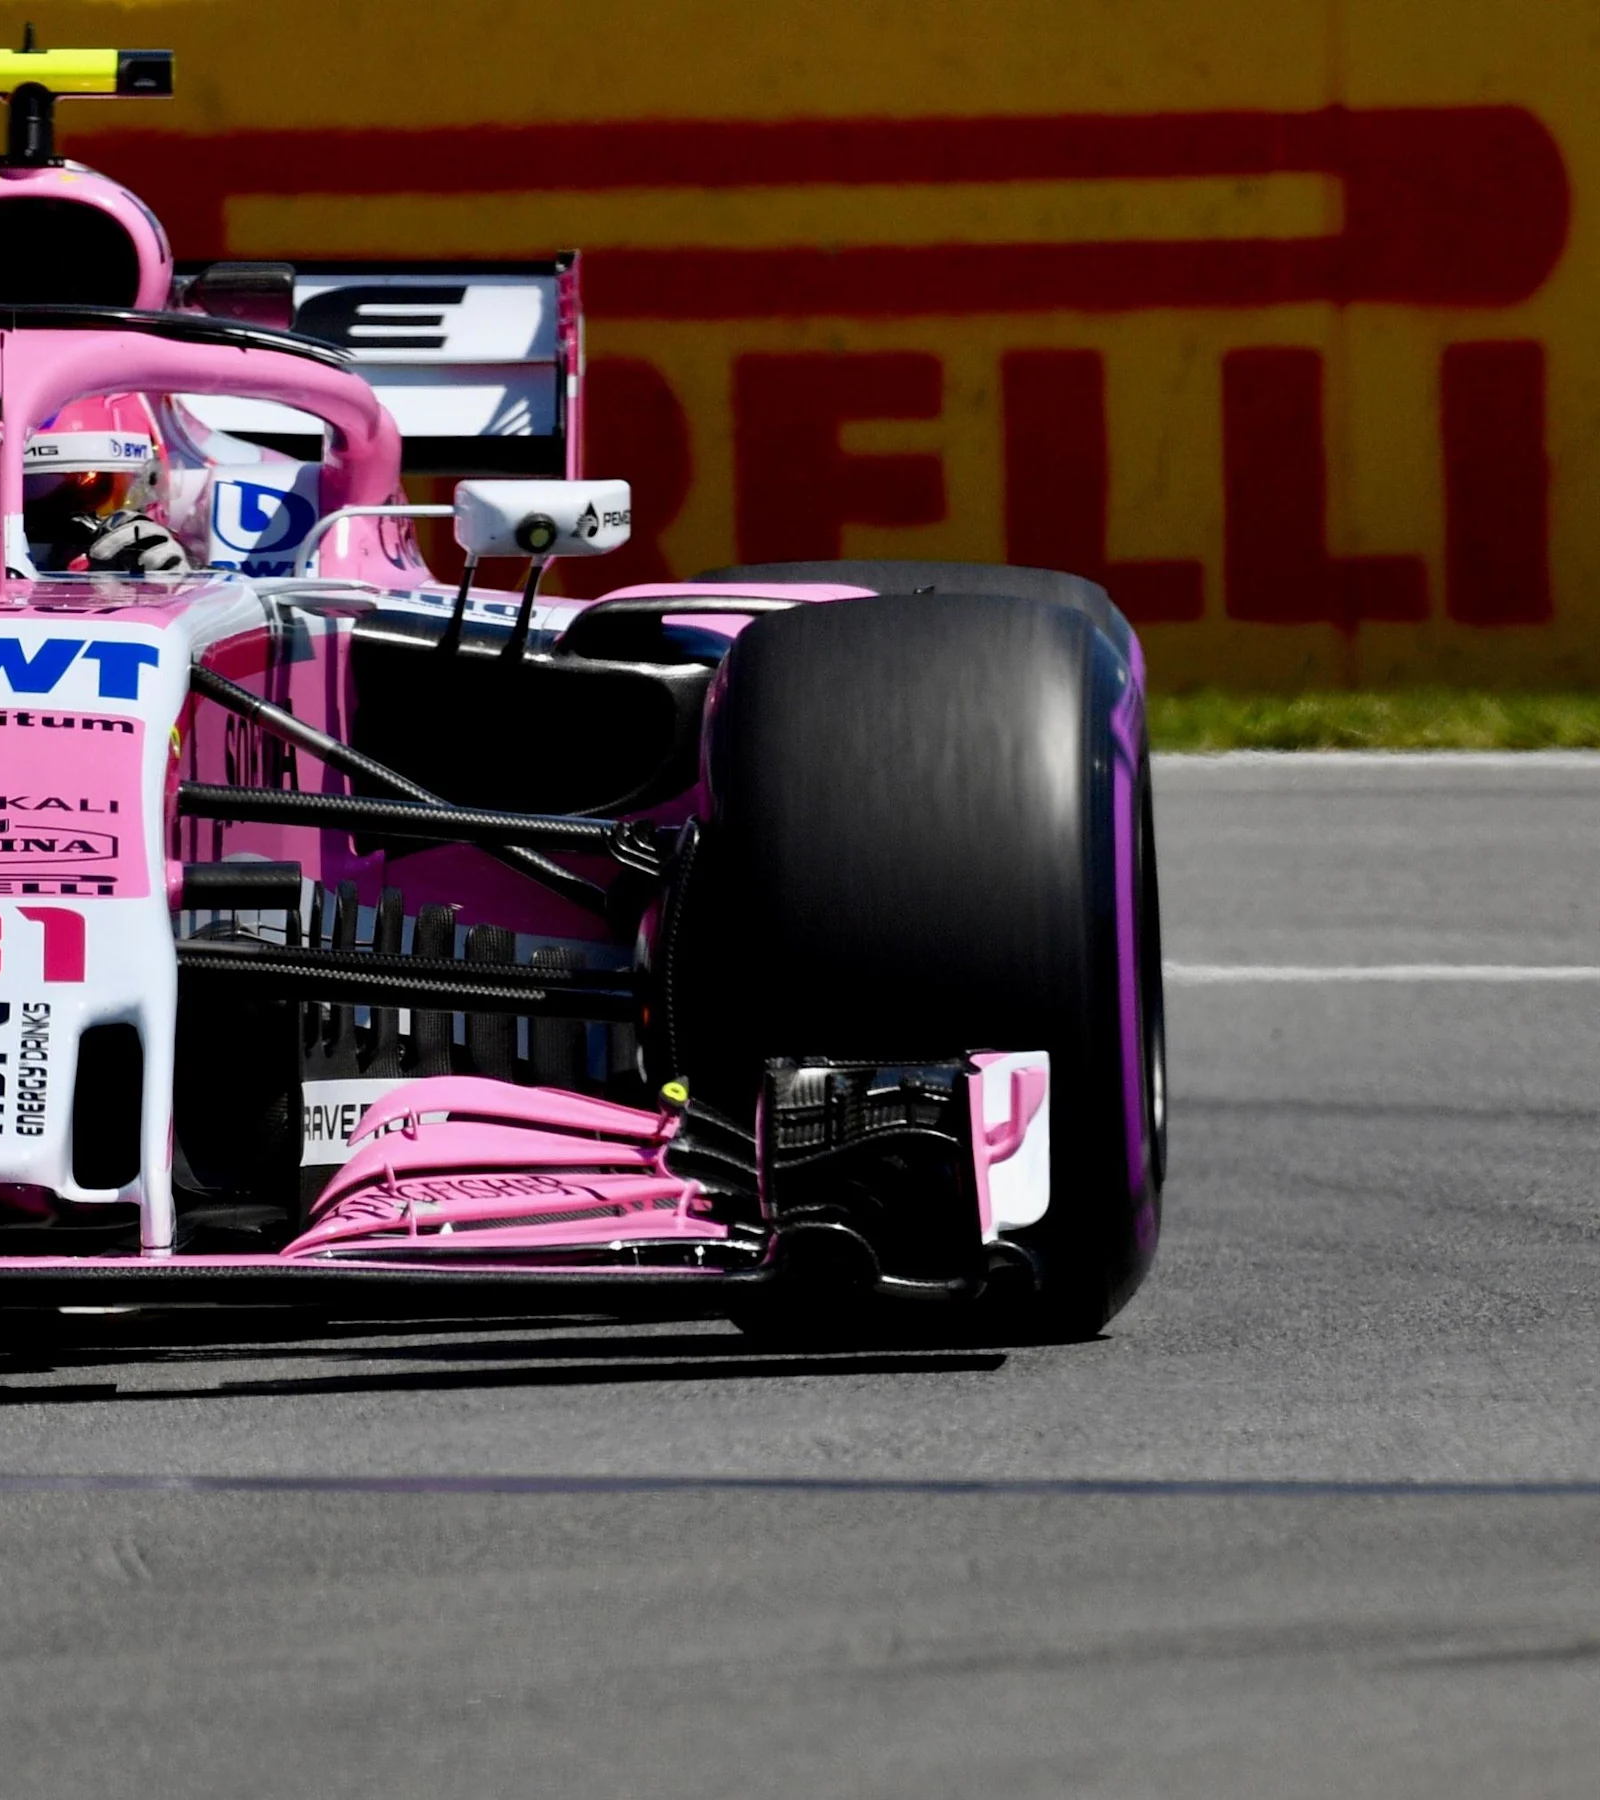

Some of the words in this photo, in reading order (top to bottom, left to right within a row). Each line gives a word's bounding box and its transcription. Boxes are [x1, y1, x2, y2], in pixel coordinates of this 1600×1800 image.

[23, 445, 59, 457] MG
[124, 442, 148, 459] BWT
[19, 1002, 51, 1062] DRINKS
[16, 1065, 48, 1136] ENERGY
